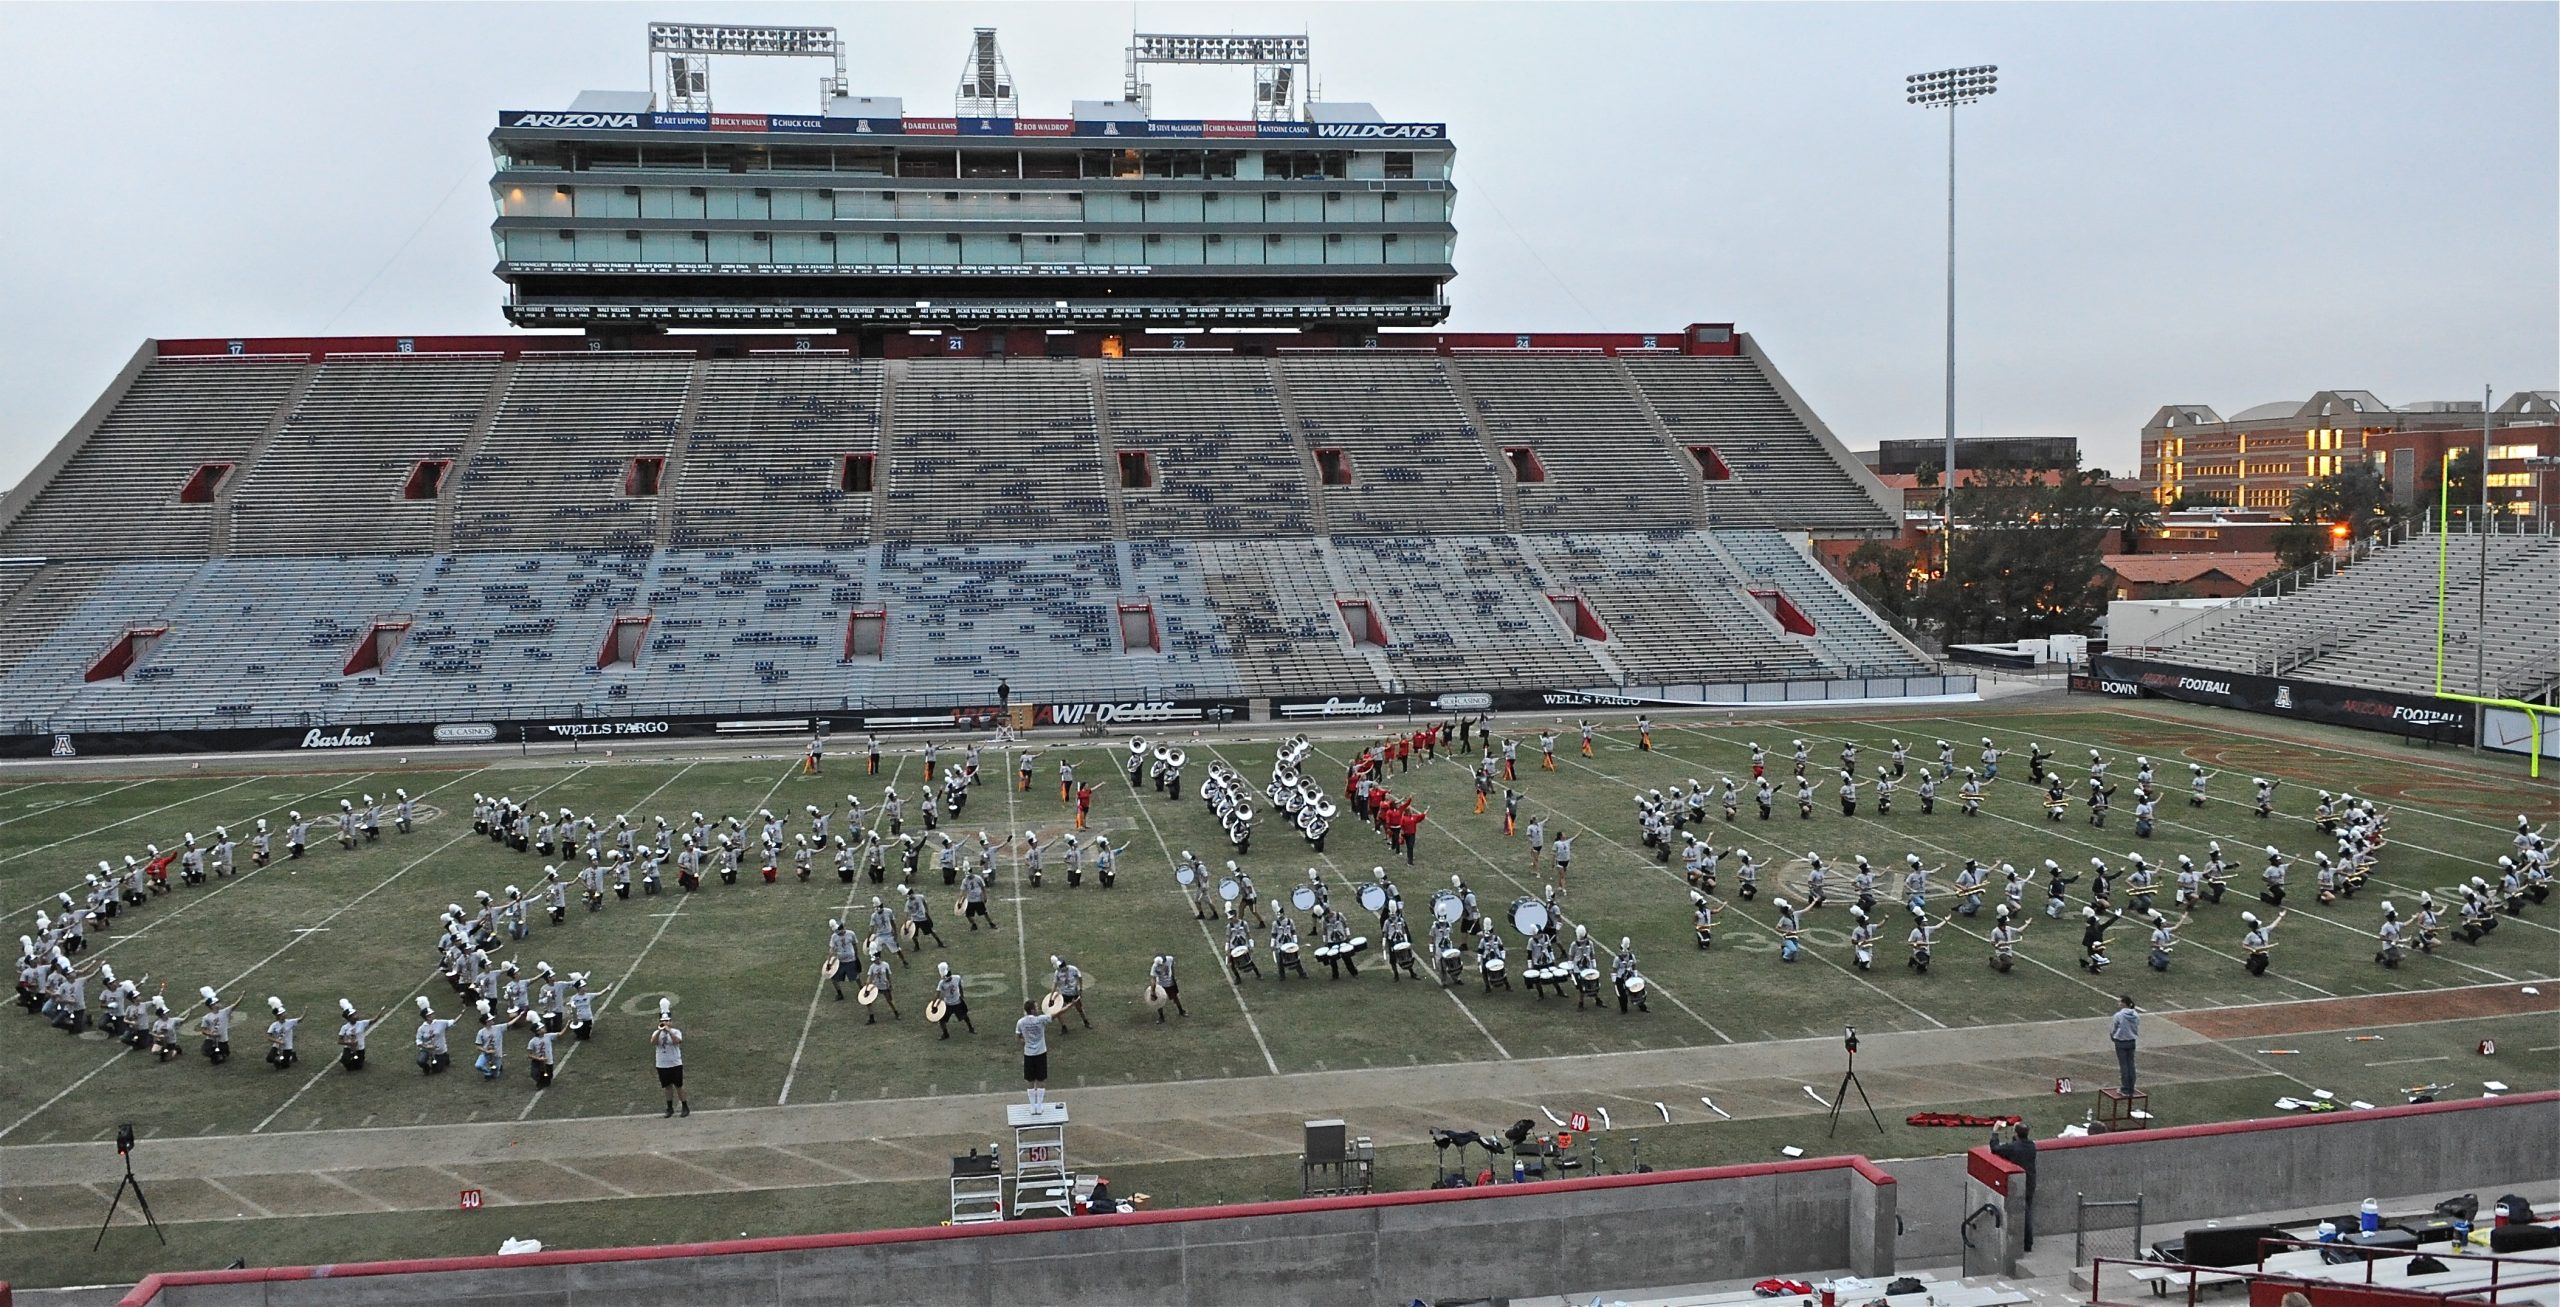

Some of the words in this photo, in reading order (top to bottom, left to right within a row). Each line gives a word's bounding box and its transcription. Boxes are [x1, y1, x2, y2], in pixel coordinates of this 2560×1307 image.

[514, 114, 638, 127] ARIZONA
[1318, 125, 1439, 137] WILDCATS
[230, 346, 241, 355] 17
[399, 343, 412, 352] 18
[588, 342, 600, 351] 19
[950, 341, 961, 349] 21
[1517, 340, 1529, 348] 24
[2101, 682, 2137, 695] DOWN
[2179, 678, 2230, 694] FOOTBALL
[1543, 695, 1591, 704] WELLS
[555, 724, 611, 735] WELLS
[615, 722, 668, 733] FARGO
[301, 728, 374, 748] Bashas'
[2483, 1040, 2494, 1054] 20
[2058, 1079, 2071, 1094] 30
[1572, 1114, 1585, 1130] 40
[1031, 1148, 1047, 1161] 50
[463, 1192, 480, 1208] 40
